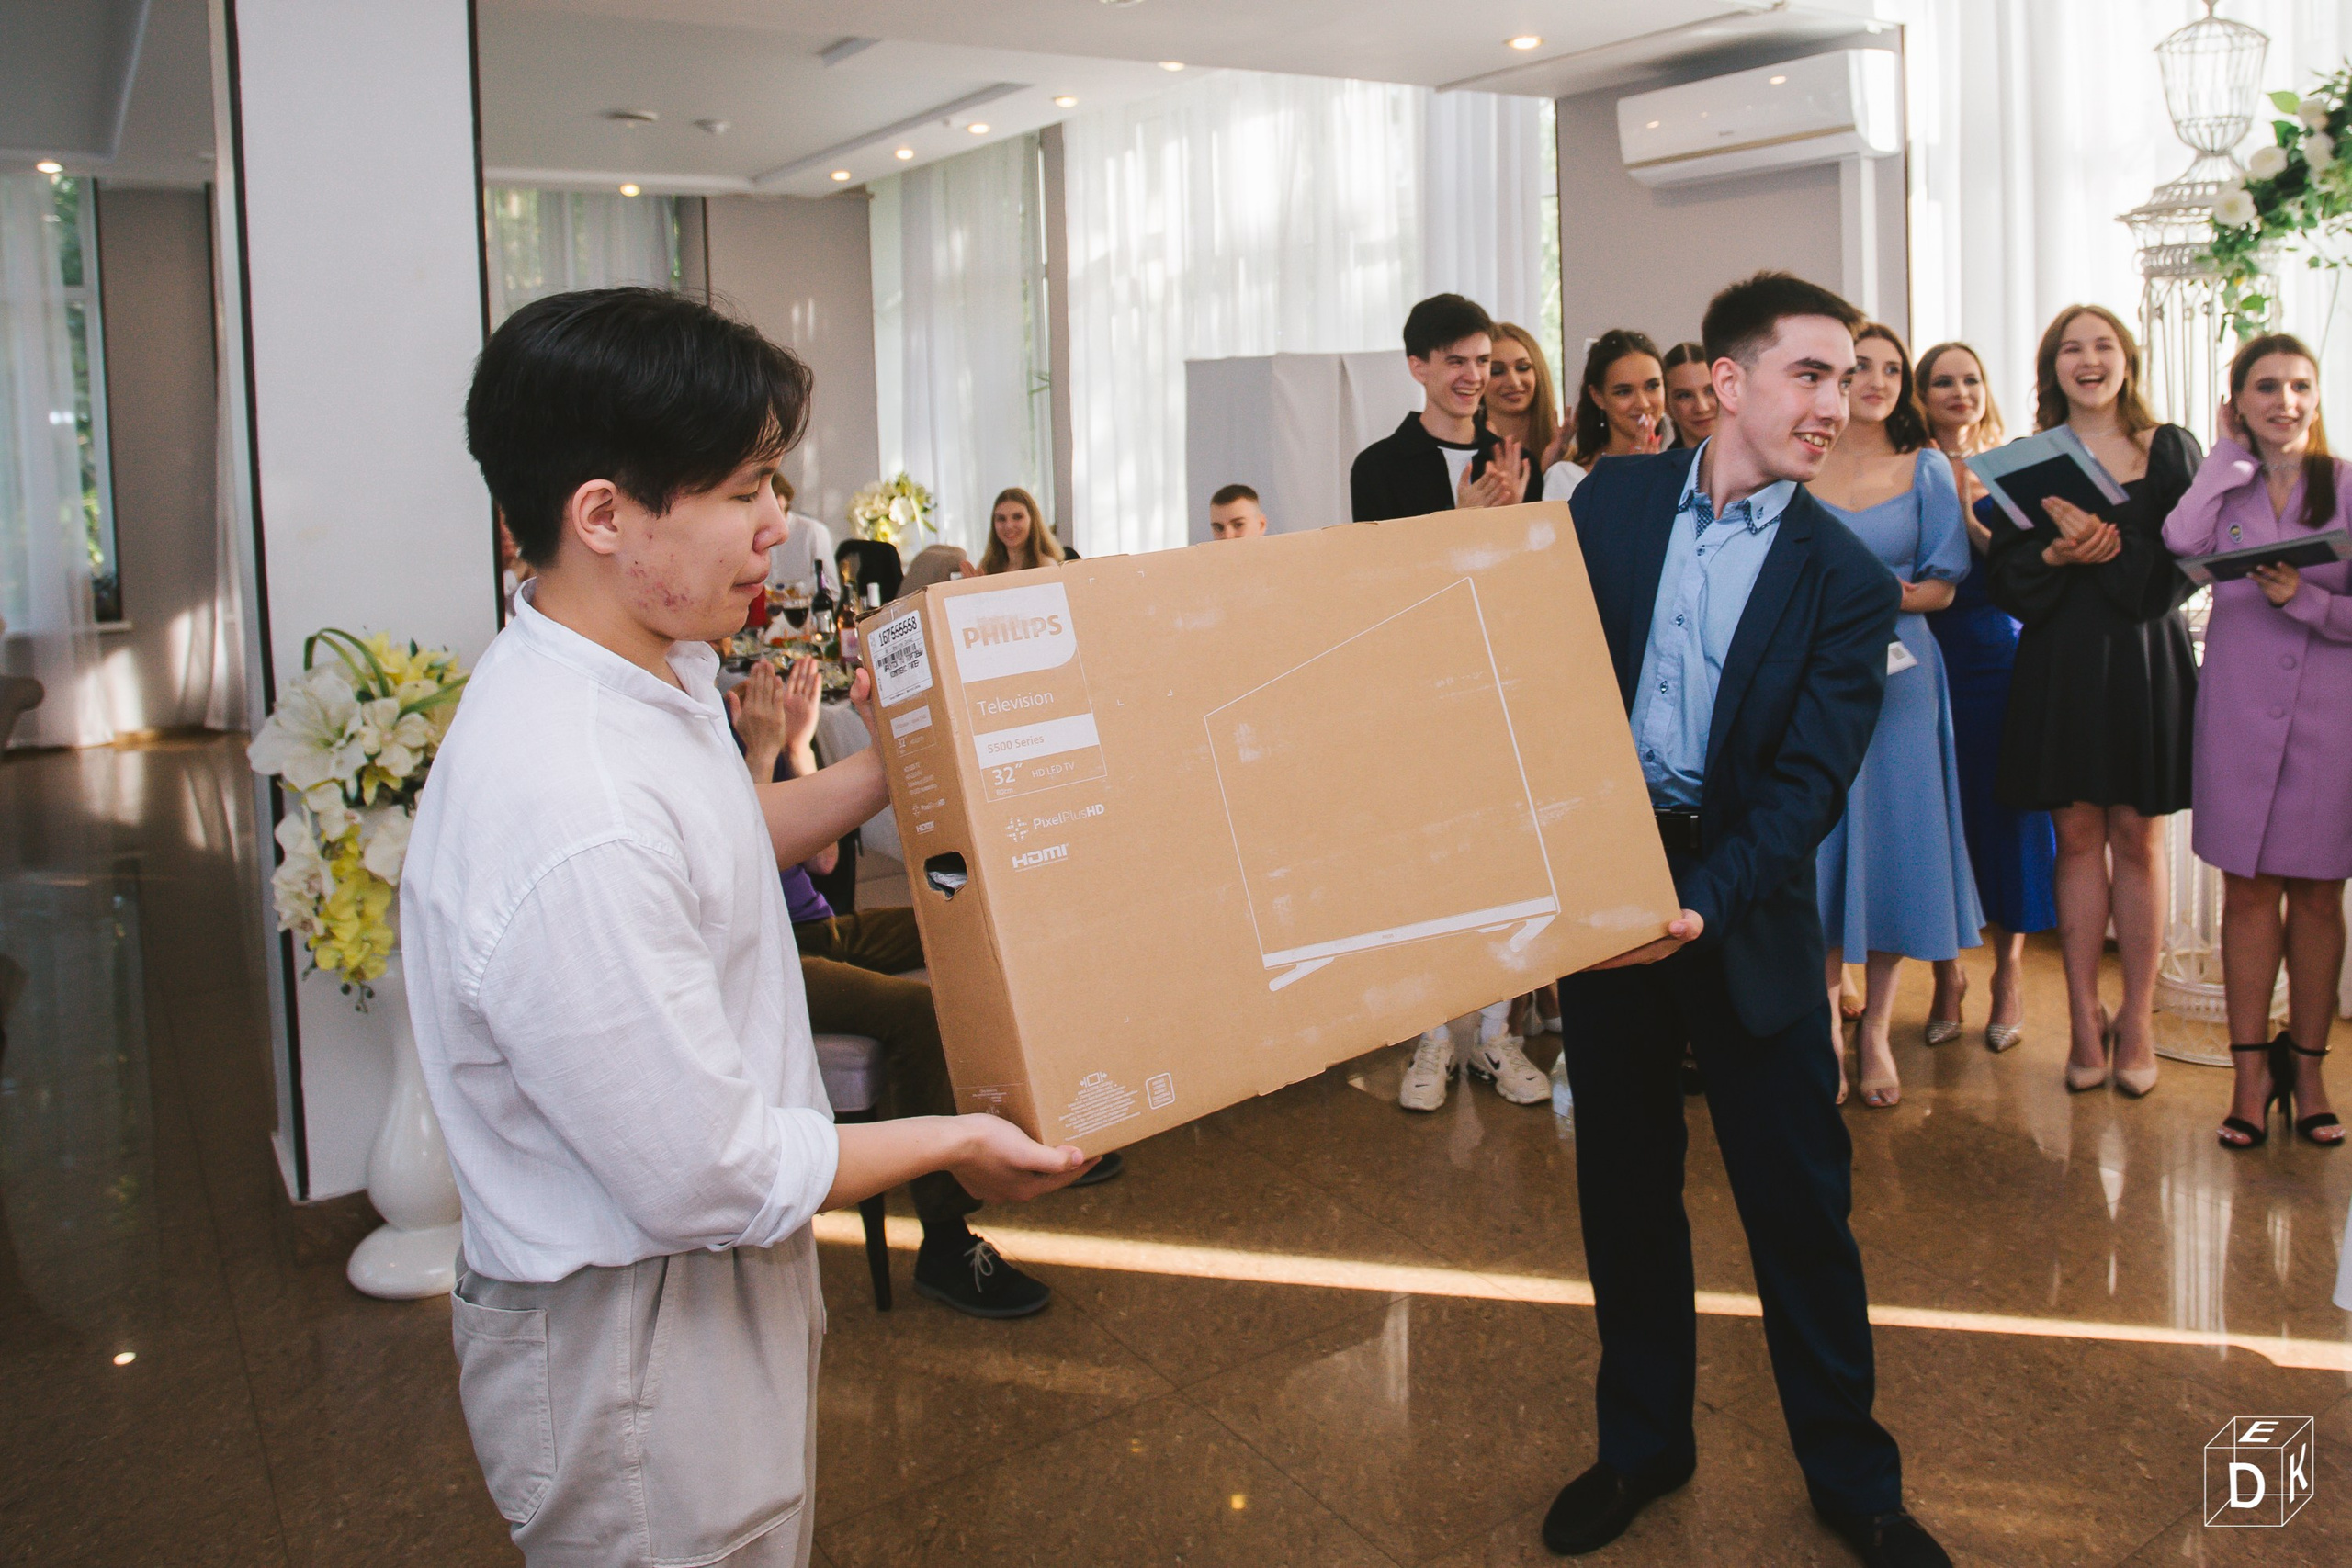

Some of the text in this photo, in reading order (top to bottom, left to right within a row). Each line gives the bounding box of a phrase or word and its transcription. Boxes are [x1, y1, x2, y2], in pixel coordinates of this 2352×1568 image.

[878, 615, 918, 647] 167555558
[962, 615, 1063, 649] PHILIPS
[977, 692, 1054, 716] Television
[988, 736, 1045, 753] 5500 Series
[1032, 770, 1046, 778] HD
[1046, 765, 1063, 775] LED
[1064, 761, 1075, 771] TV
[1032, 803, 1105, 829] PixelPlusHD
[1012, 843, 1068, 869] HDMI
